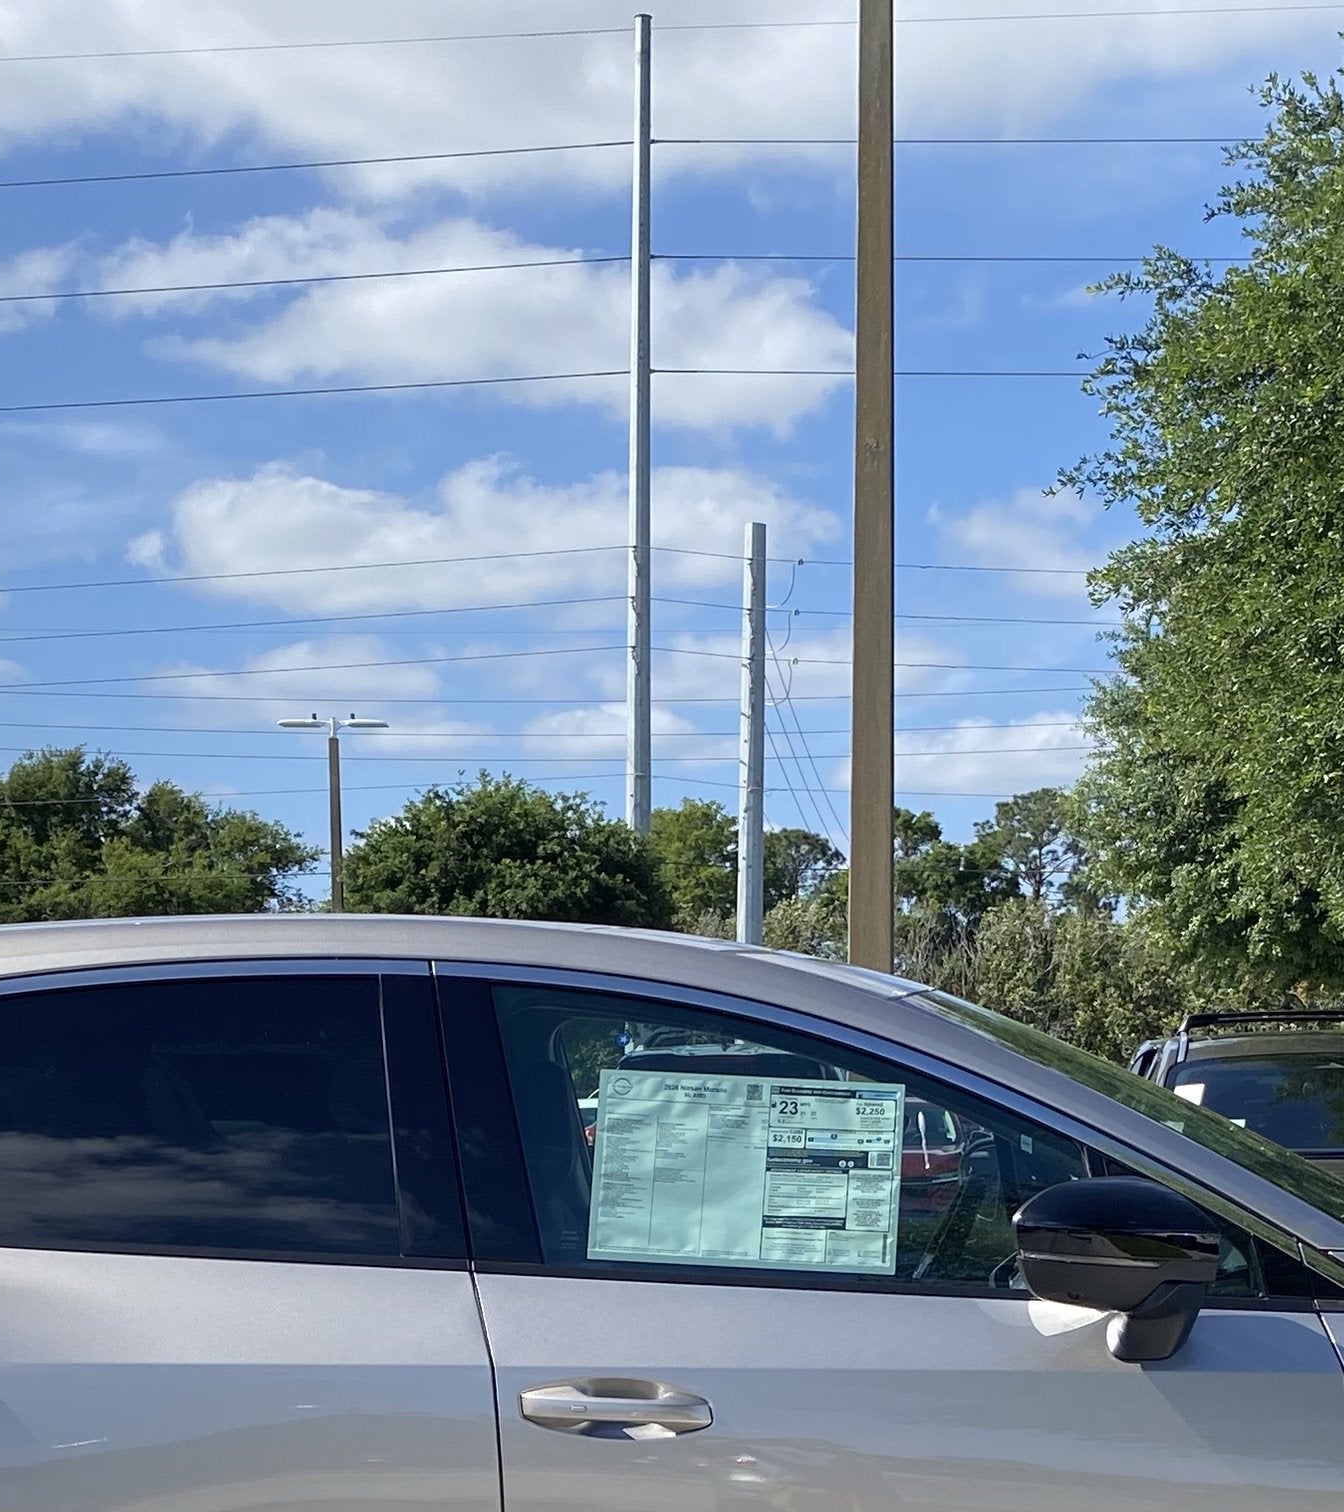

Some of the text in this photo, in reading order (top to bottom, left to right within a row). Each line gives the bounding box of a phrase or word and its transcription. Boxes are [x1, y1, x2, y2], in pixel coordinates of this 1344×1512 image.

[778, 1100, 798, 1116] 23
[855, 1107, 886, 1116] $2,250
[772, 1134, 803, 1144] $2,150
